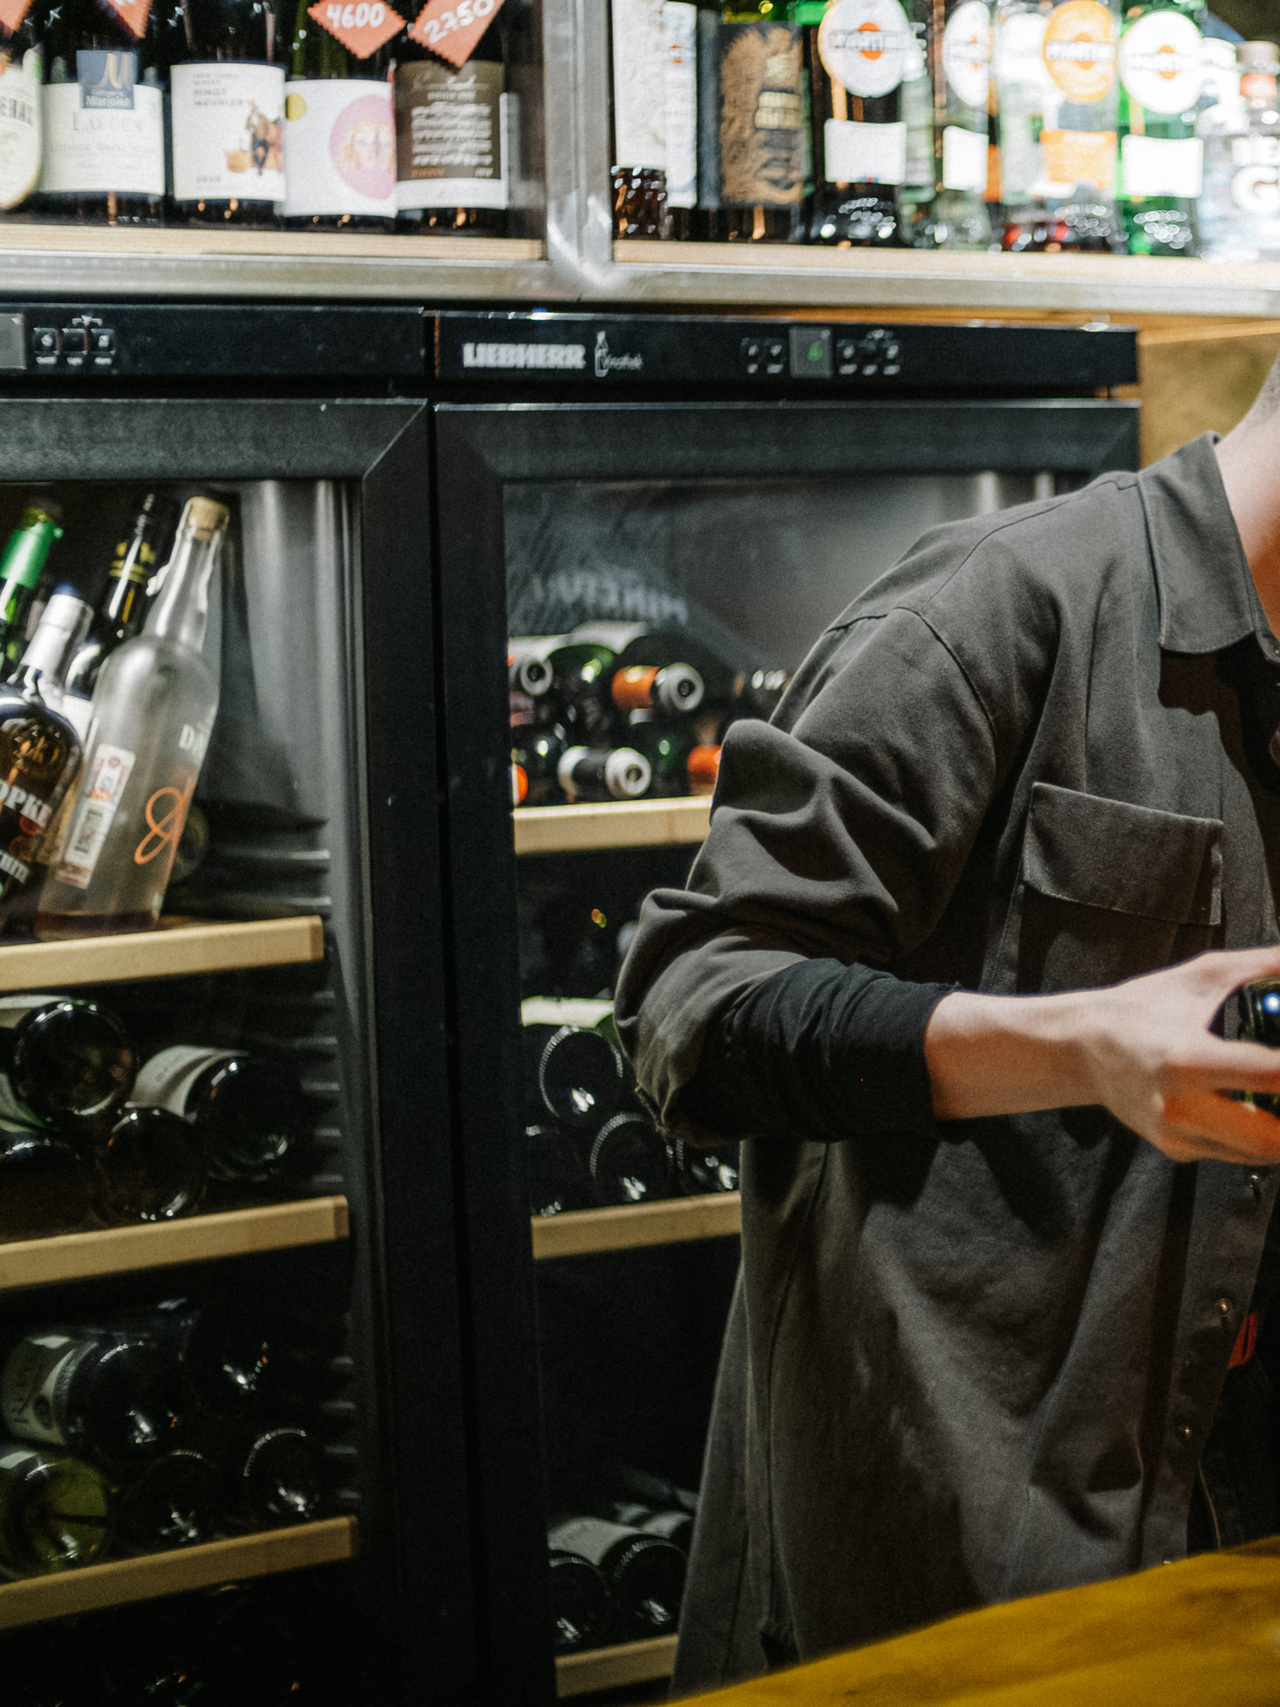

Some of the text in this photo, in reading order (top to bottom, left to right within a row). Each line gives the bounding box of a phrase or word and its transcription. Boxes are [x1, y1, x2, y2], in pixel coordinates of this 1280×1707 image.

[326, 2, 386, 29] 4600
[424, 0, 495, 43] 2750
[463, 342, 586, 369] LIEBHERR
